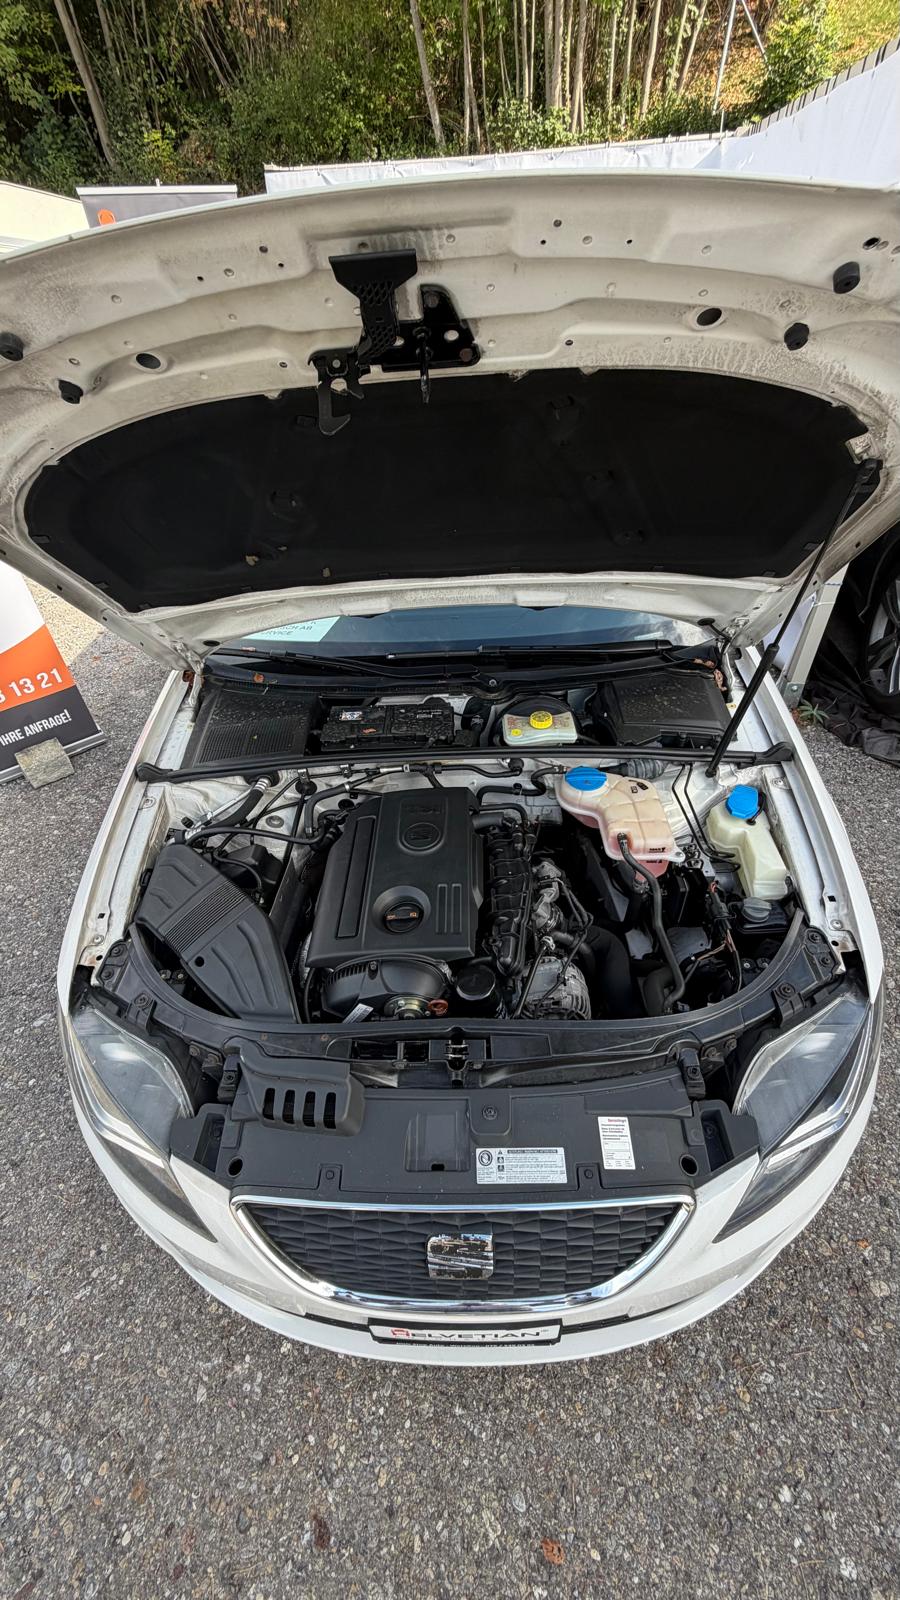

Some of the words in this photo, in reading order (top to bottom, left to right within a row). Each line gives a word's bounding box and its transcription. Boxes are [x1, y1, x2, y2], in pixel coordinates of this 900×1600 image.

[9, 678, 35, 697] 13
[36, 668, 63, 688] 21
[0, 728, 25, 746] IHRE
[24, 709, 72, 737] ANFRAGE!
